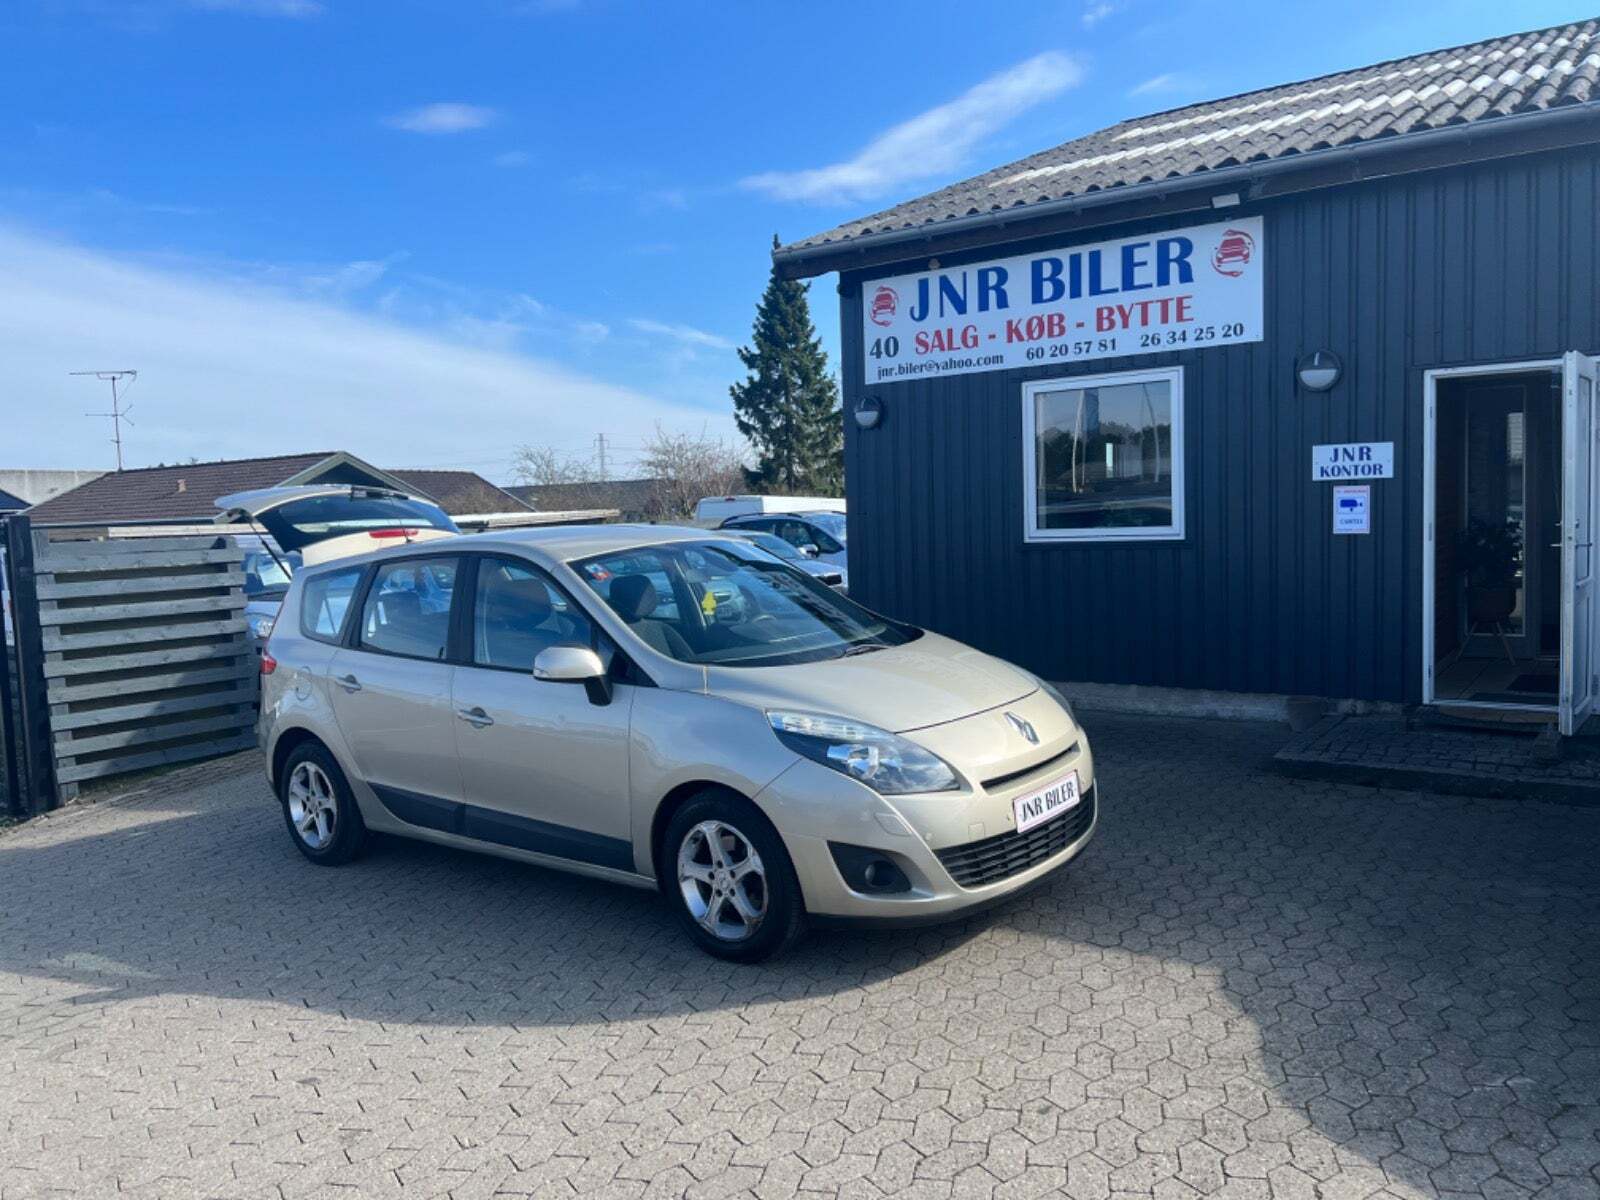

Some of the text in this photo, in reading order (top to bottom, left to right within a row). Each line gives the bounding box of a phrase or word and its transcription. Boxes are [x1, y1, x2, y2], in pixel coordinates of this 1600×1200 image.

[909, 236, 1194, 322] JNR BILER
[915, 324, 979, 356] SALG
[1006, 312, 1066, 344] KØB
[1095, 295, 1195, 332] BYTTE
[1140, 322, 1244, 348] 26 34 25 20
[869, 336, 899, 359] 40
[1026, 338, 1117, 361] 60 20 57 81
[877, 354, 1004, 380] jnr.biler@yahoo.com
[1330, 446, 1372, 463] JNR
[1320, 464, 1383, 478] KONTOR
[1022, 781, 1074, 822] JNR BILER
